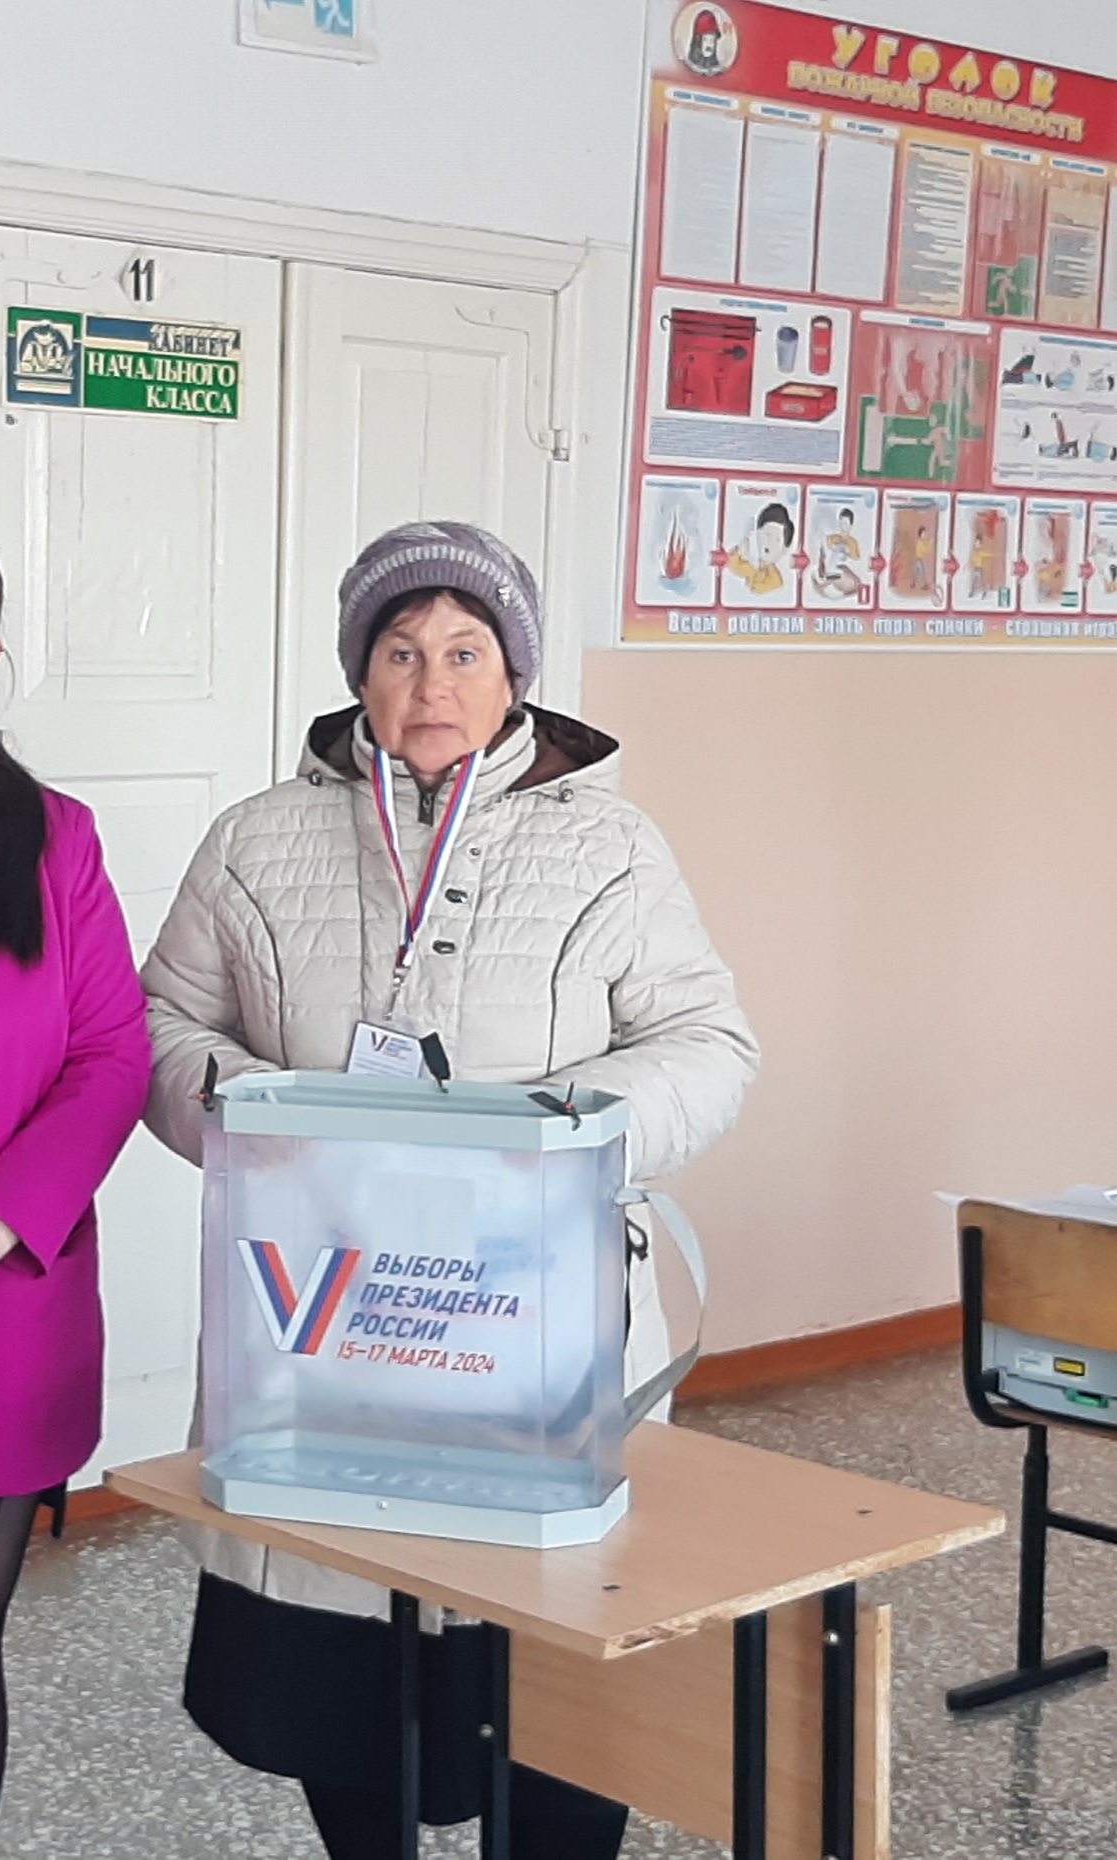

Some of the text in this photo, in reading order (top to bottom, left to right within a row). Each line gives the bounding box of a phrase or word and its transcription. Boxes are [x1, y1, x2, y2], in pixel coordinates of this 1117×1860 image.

[832, 23, 1057, 110] УГОЛОК
[131, 258, 156, 302] 11
[87, 351, 236, 386] НАЧАЛЬНОГО
[146, 384, 233, 414] КЛАССА
[372, 1252, 486, 1284] ВЫБОРЫ
[359, 1282, 519, 1319] ПРЕЗИДЕНТА
[345, 1312, 449, 1342] РОССИИ
[387, 1345, 447, 1370] МАРТА
[450, 1352, 496, 1374] 2024
